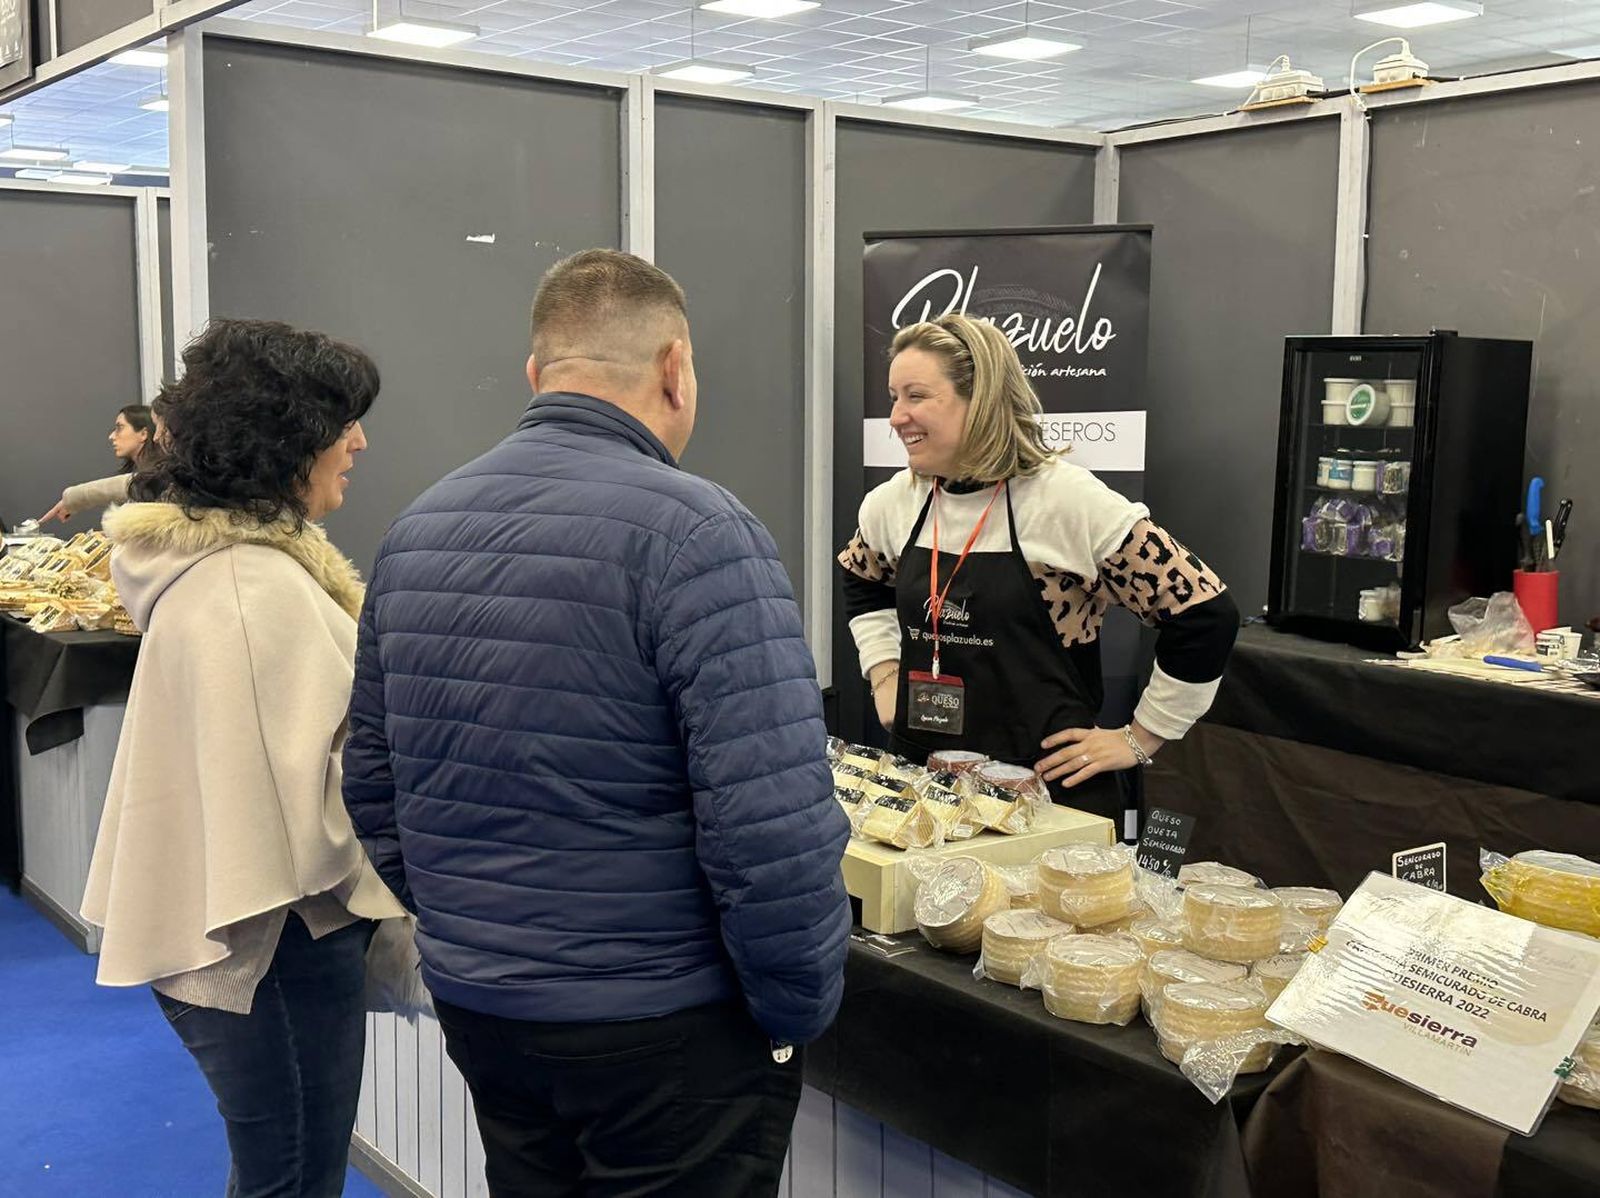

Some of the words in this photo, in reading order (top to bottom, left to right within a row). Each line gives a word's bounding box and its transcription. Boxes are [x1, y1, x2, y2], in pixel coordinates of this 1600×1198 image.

[1050, 365, 1107, 378] artesana
[1040, 421, 1116, 442] ESEROS
[1151, 810, 1182, 826] QUESO
[1402, 867, 1436, 881] CABRA
[1408, 963, 1487, 1000] SEMICURADO
[1506, 1001, 1548, 1023] CABRA
[1455, 999, 1490, 1020] 2022
